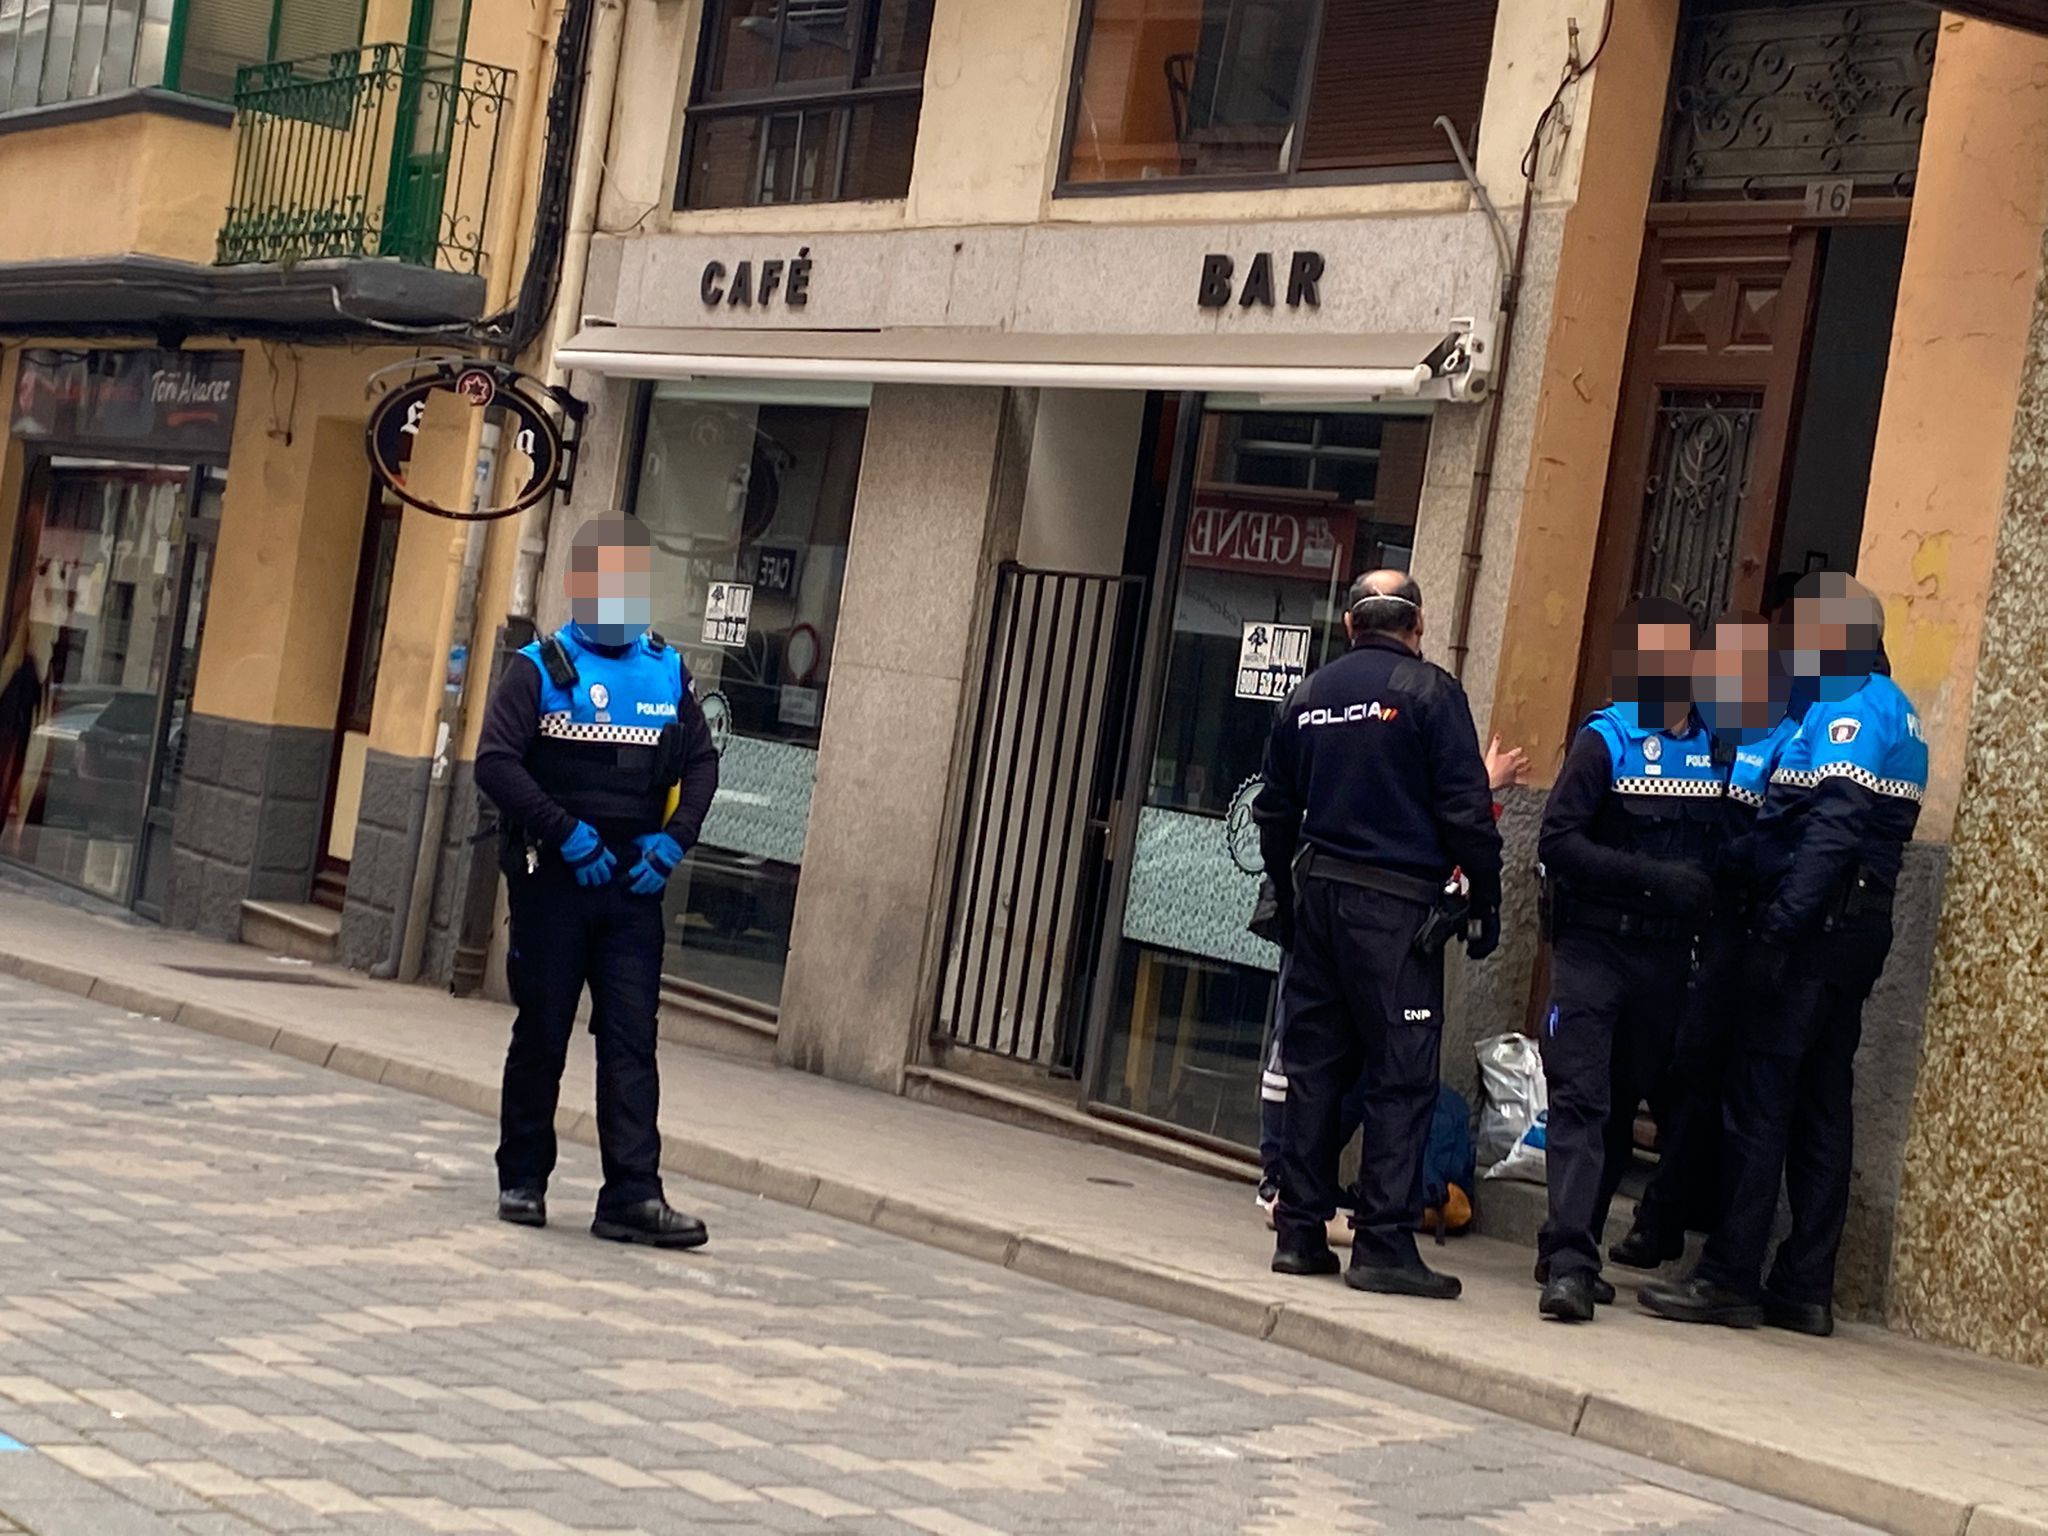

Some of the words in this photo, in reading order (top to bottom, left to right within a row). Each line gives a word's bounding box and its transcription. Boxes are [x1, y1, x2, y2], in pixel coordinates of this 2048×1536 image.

[1814, 184, 1845, 212] 16
[701, 247, 812, 307] CAFÉ
[1198, 251, 1325, 309] BAR
[1273, 673, 1287, 696] 22
[1298, 702, 1381, 729] POLICIA
[1404, 1009, 1431, 1020] CNP
